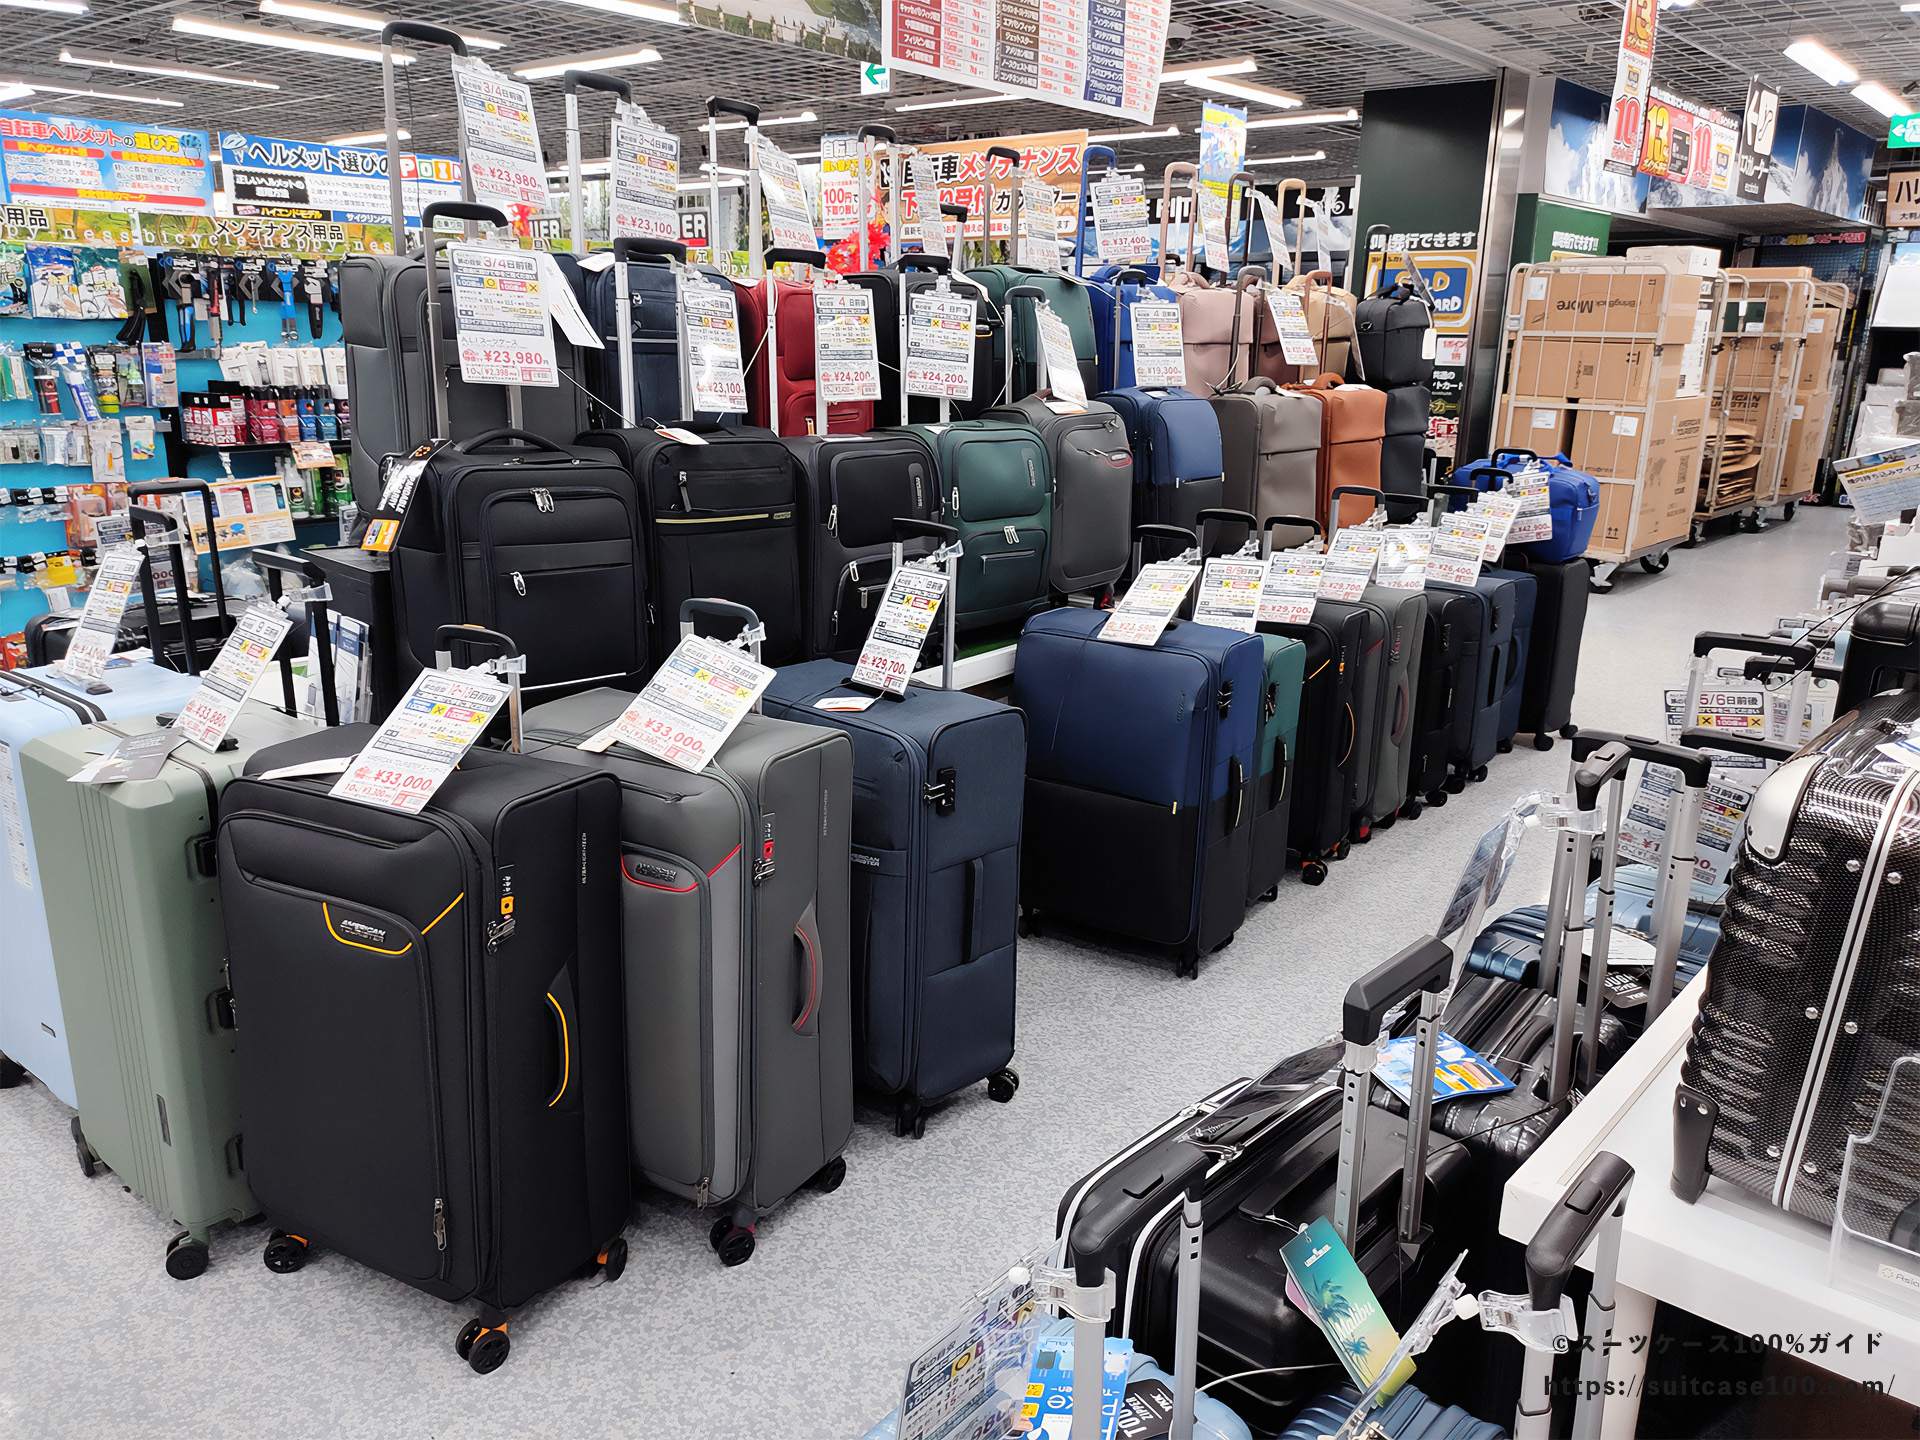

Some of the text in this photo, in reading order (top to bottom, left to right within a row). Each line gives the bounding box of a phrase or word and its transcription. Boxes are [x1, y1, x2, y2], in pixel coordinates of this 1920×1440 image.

[0, 118, 180, 153] 自転車ヘルメットの選び方
[217, 219, 344, 243] メンテナンス用品
[483, 256, 534, 270] 3/4日前後
[1556, 300, 1594, 314] More
[1700, 693, 1758, 706] 5/6日前後
[1334, 1300, 1375, 1341] Malibu
[1126, 1396, 1154, 1422] ZIPPER
